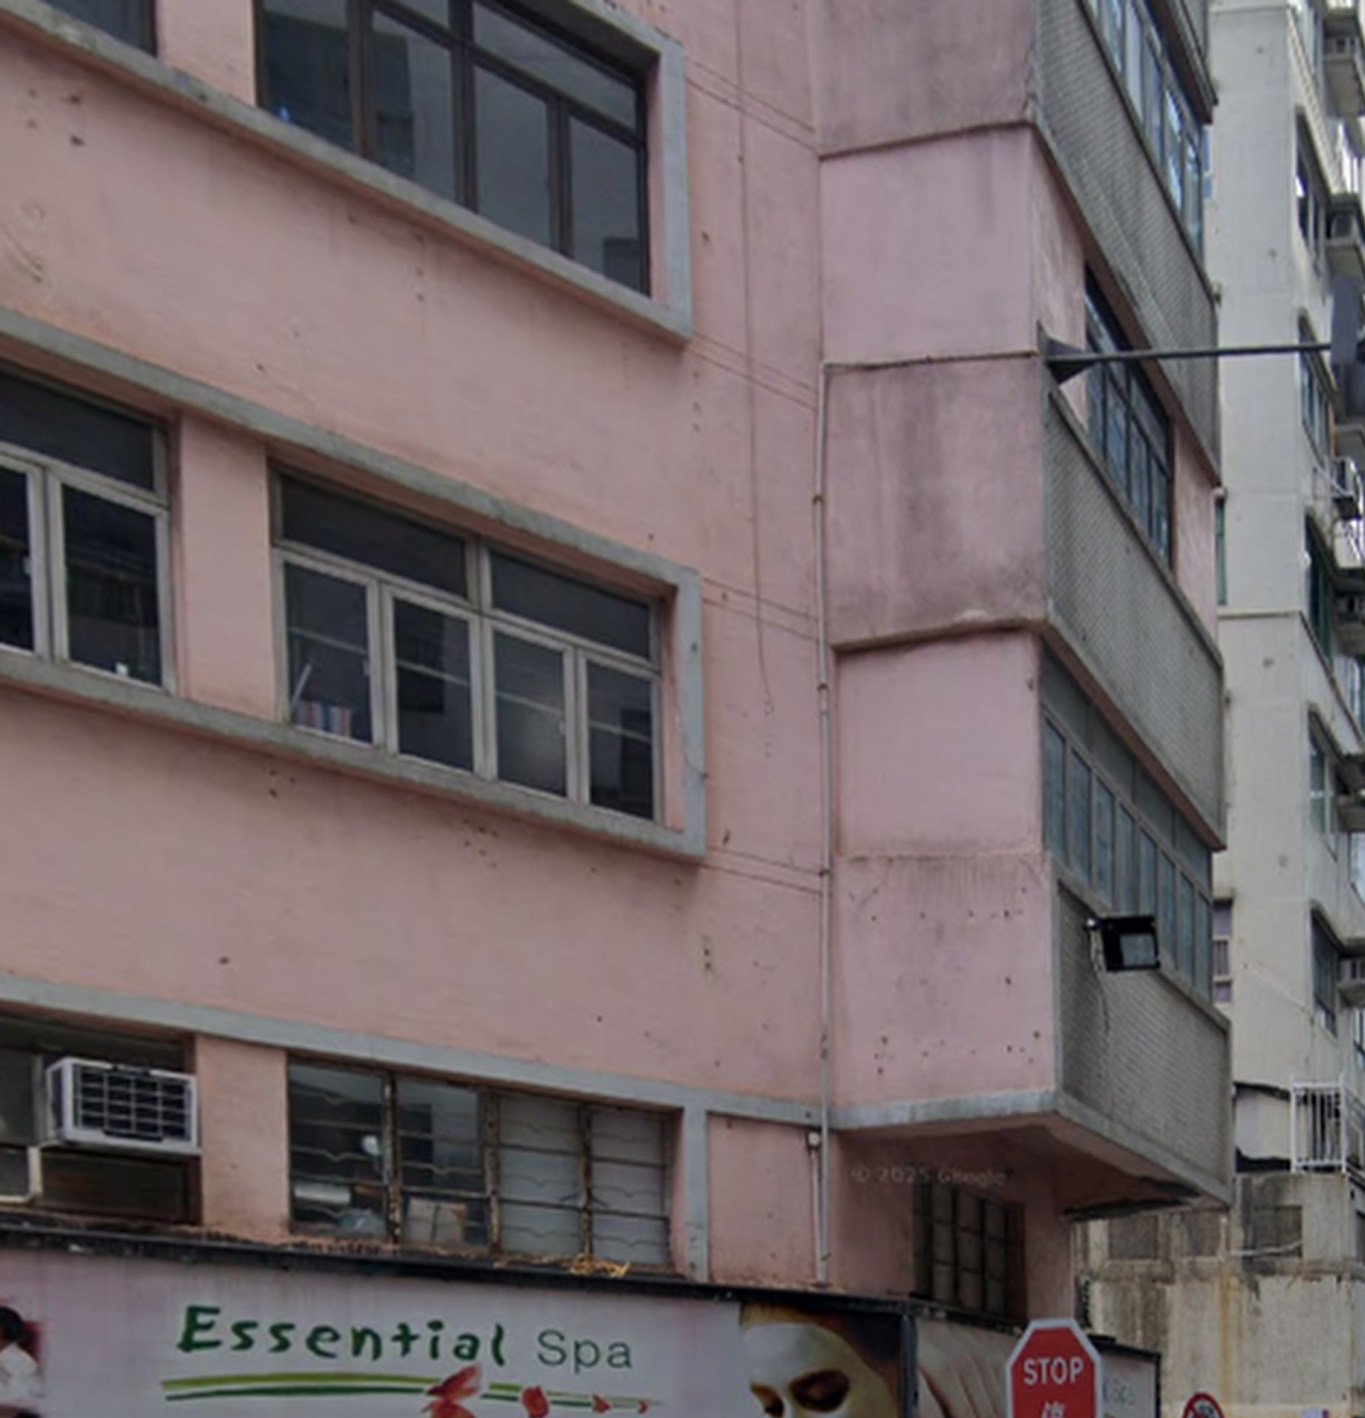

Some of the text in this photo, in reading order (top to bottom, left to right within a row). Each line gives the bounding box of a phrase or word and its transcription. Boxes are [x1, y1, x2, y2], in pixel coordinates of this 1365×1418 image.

[177, 1305, 633, 1375] Essential Spa
[1023, 1356, 1084, 1386] STOP
